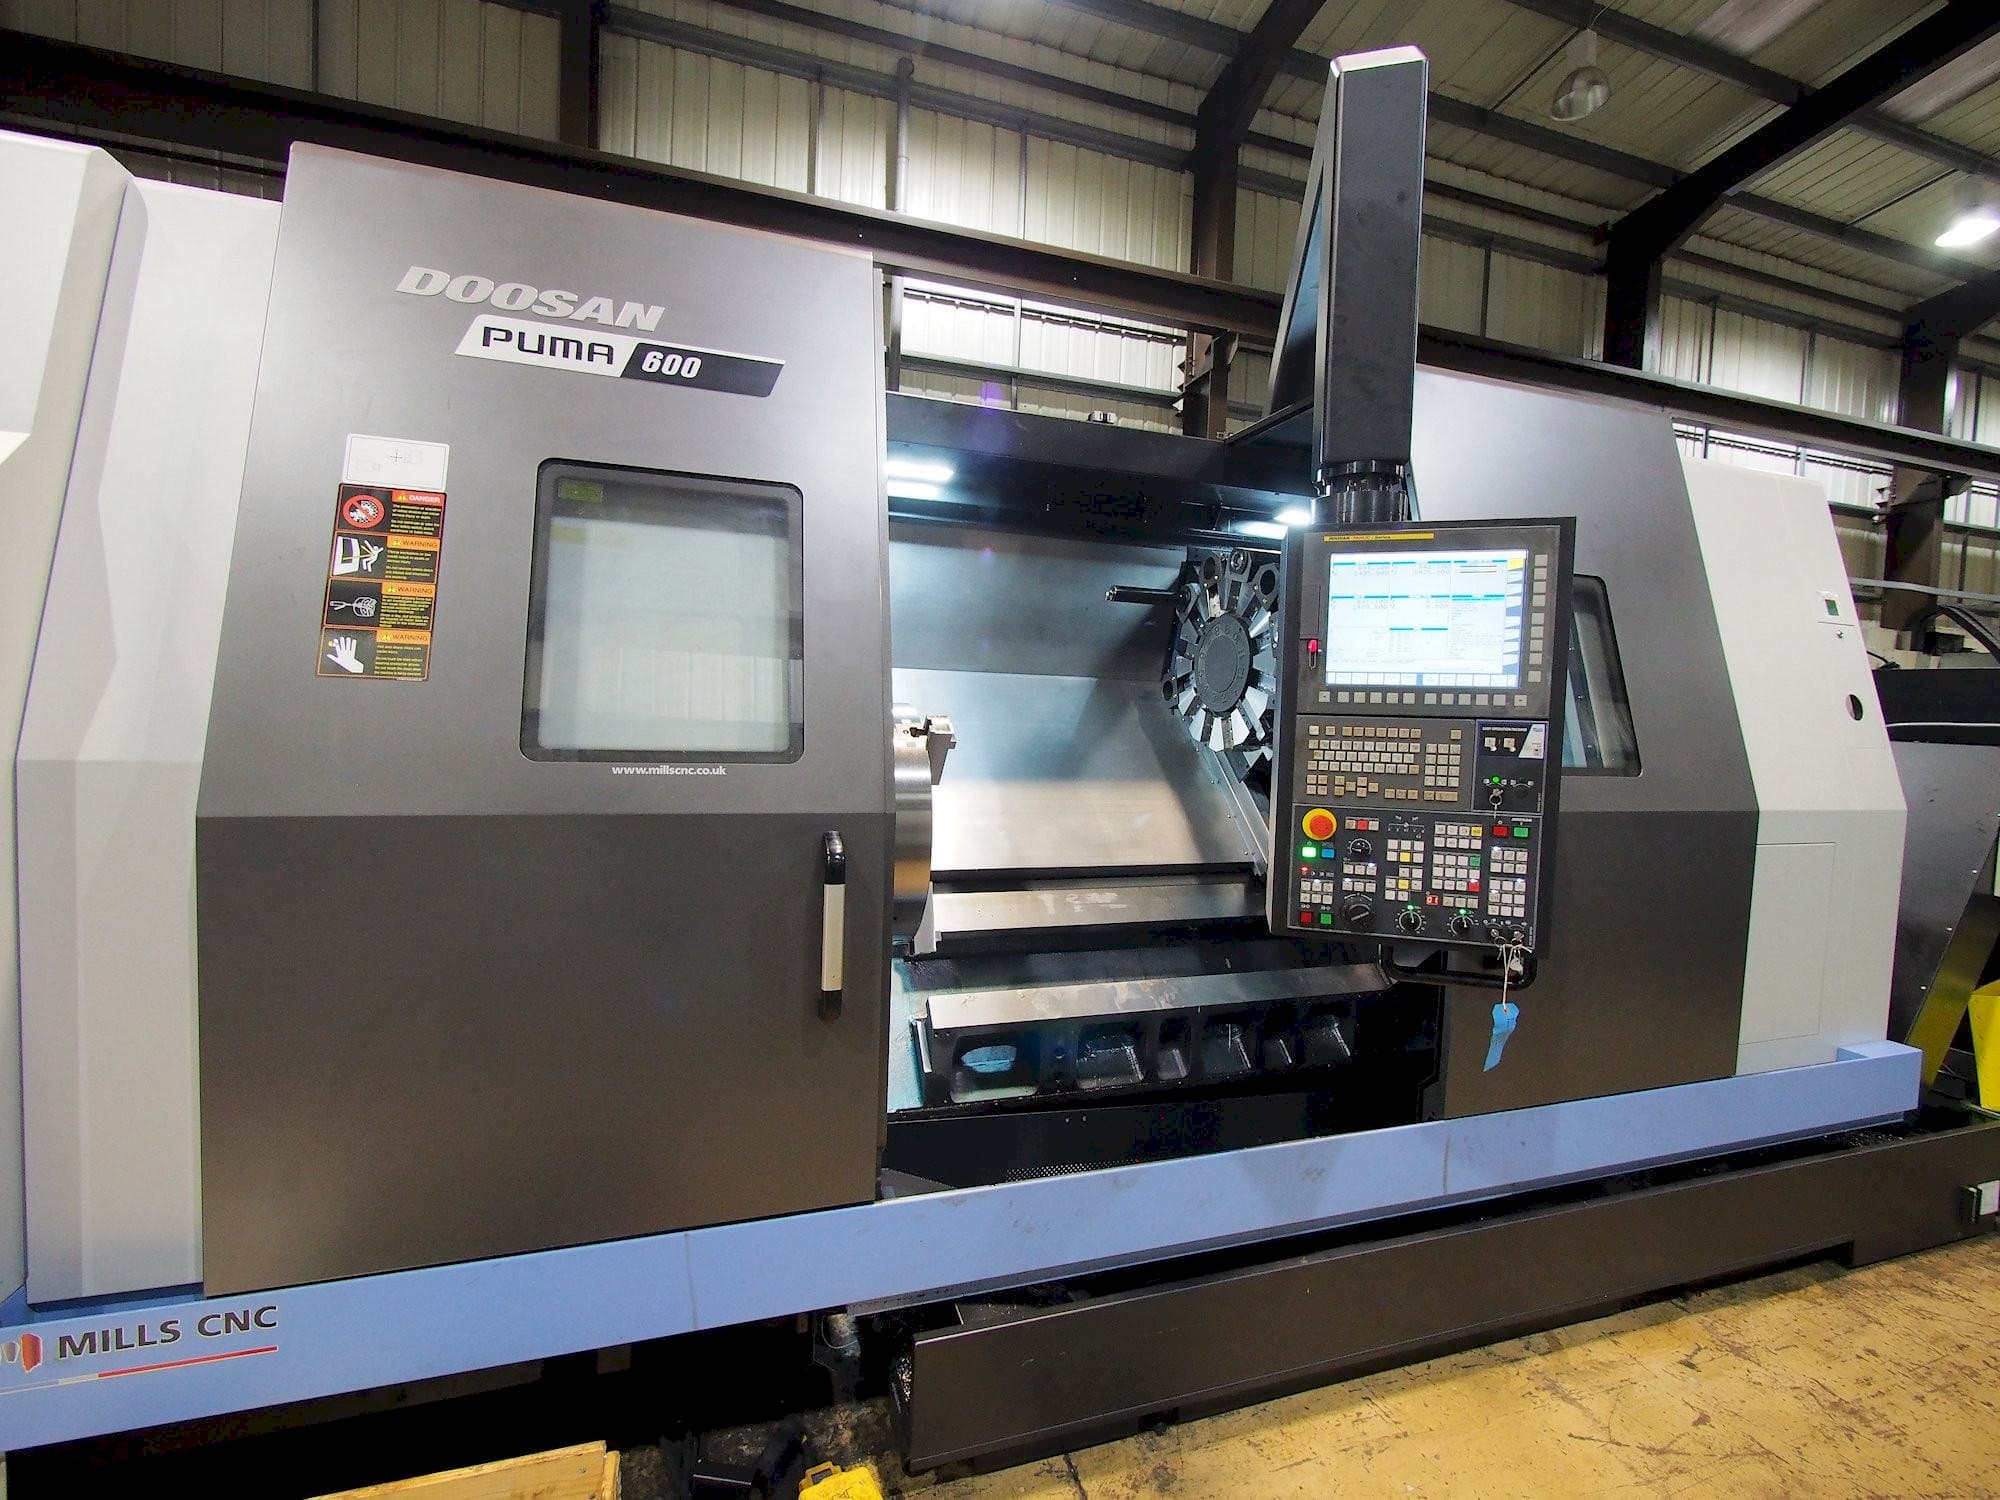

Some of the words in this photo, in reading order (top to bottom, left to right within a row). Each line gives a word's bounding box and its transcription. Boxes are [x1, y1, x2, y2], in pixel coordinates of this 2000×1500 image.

[396, 266, 666, 332] DOOSAN
[482, 326, 614, 365] PUMA
[641, 351, 702, 379] 600
[408, 494, 441, 503] DANGER
[402, 540, 438, 548] WARNING
[397, 586, 433, 595] WARNING
[392, 633, 428, 642] WARNING
[611, 764, 727, 776] www.millscnc.co.uk
[58, 1319, 181, 1360] MILLS
[197, 1305, 278, 1338] CNC
